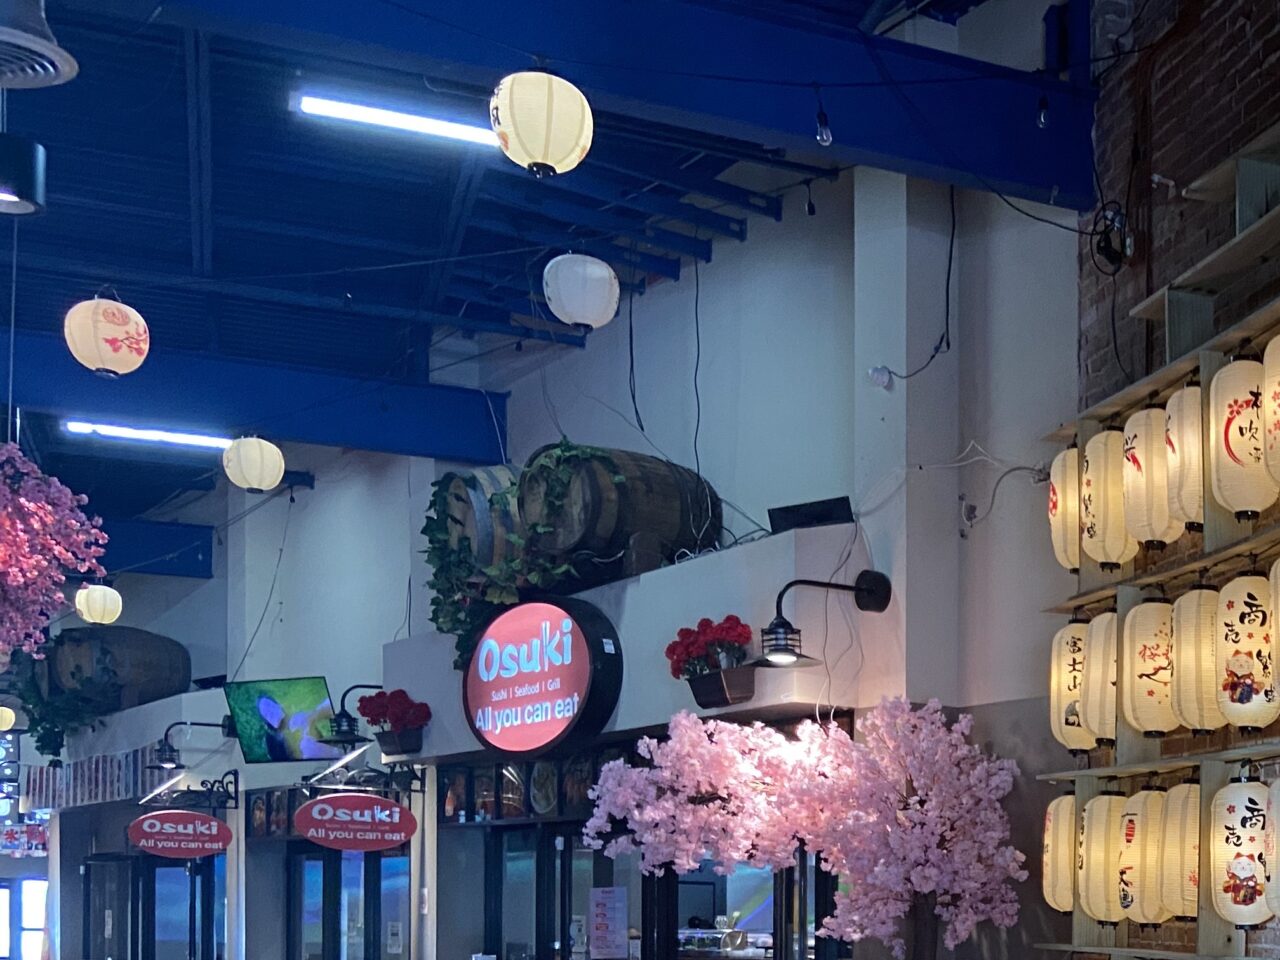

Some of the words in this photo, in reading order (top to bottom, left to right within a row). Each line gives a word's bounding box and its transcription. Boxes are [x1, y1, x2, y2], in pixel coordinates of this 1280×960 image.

[478, 617, 574, 682] Osuki
[491, 687, 508, 702] Sushi
[514, 681, 540, 698] Seafood
[547, 677, 561, 691] Grill
[475, 706, 492, 732] All
[495, 705, 521, 735] you
[524, 701, 551, 724] can
[554, 692, 580, 719] eat
[311, 803, 401, 824] Osuki
[142, 819, 218, 836] Osuki
[307, 827, 325, 839] All
[328, 830, 354, 840] you
[356, 831, 381, 841] can
[384, 831, 406, 841] eat
[139, 839, 155, 848] All
[156, 840, 179, 849] you
[181, 841, 202, 849] can
[204, 841, 223, 849] eat
